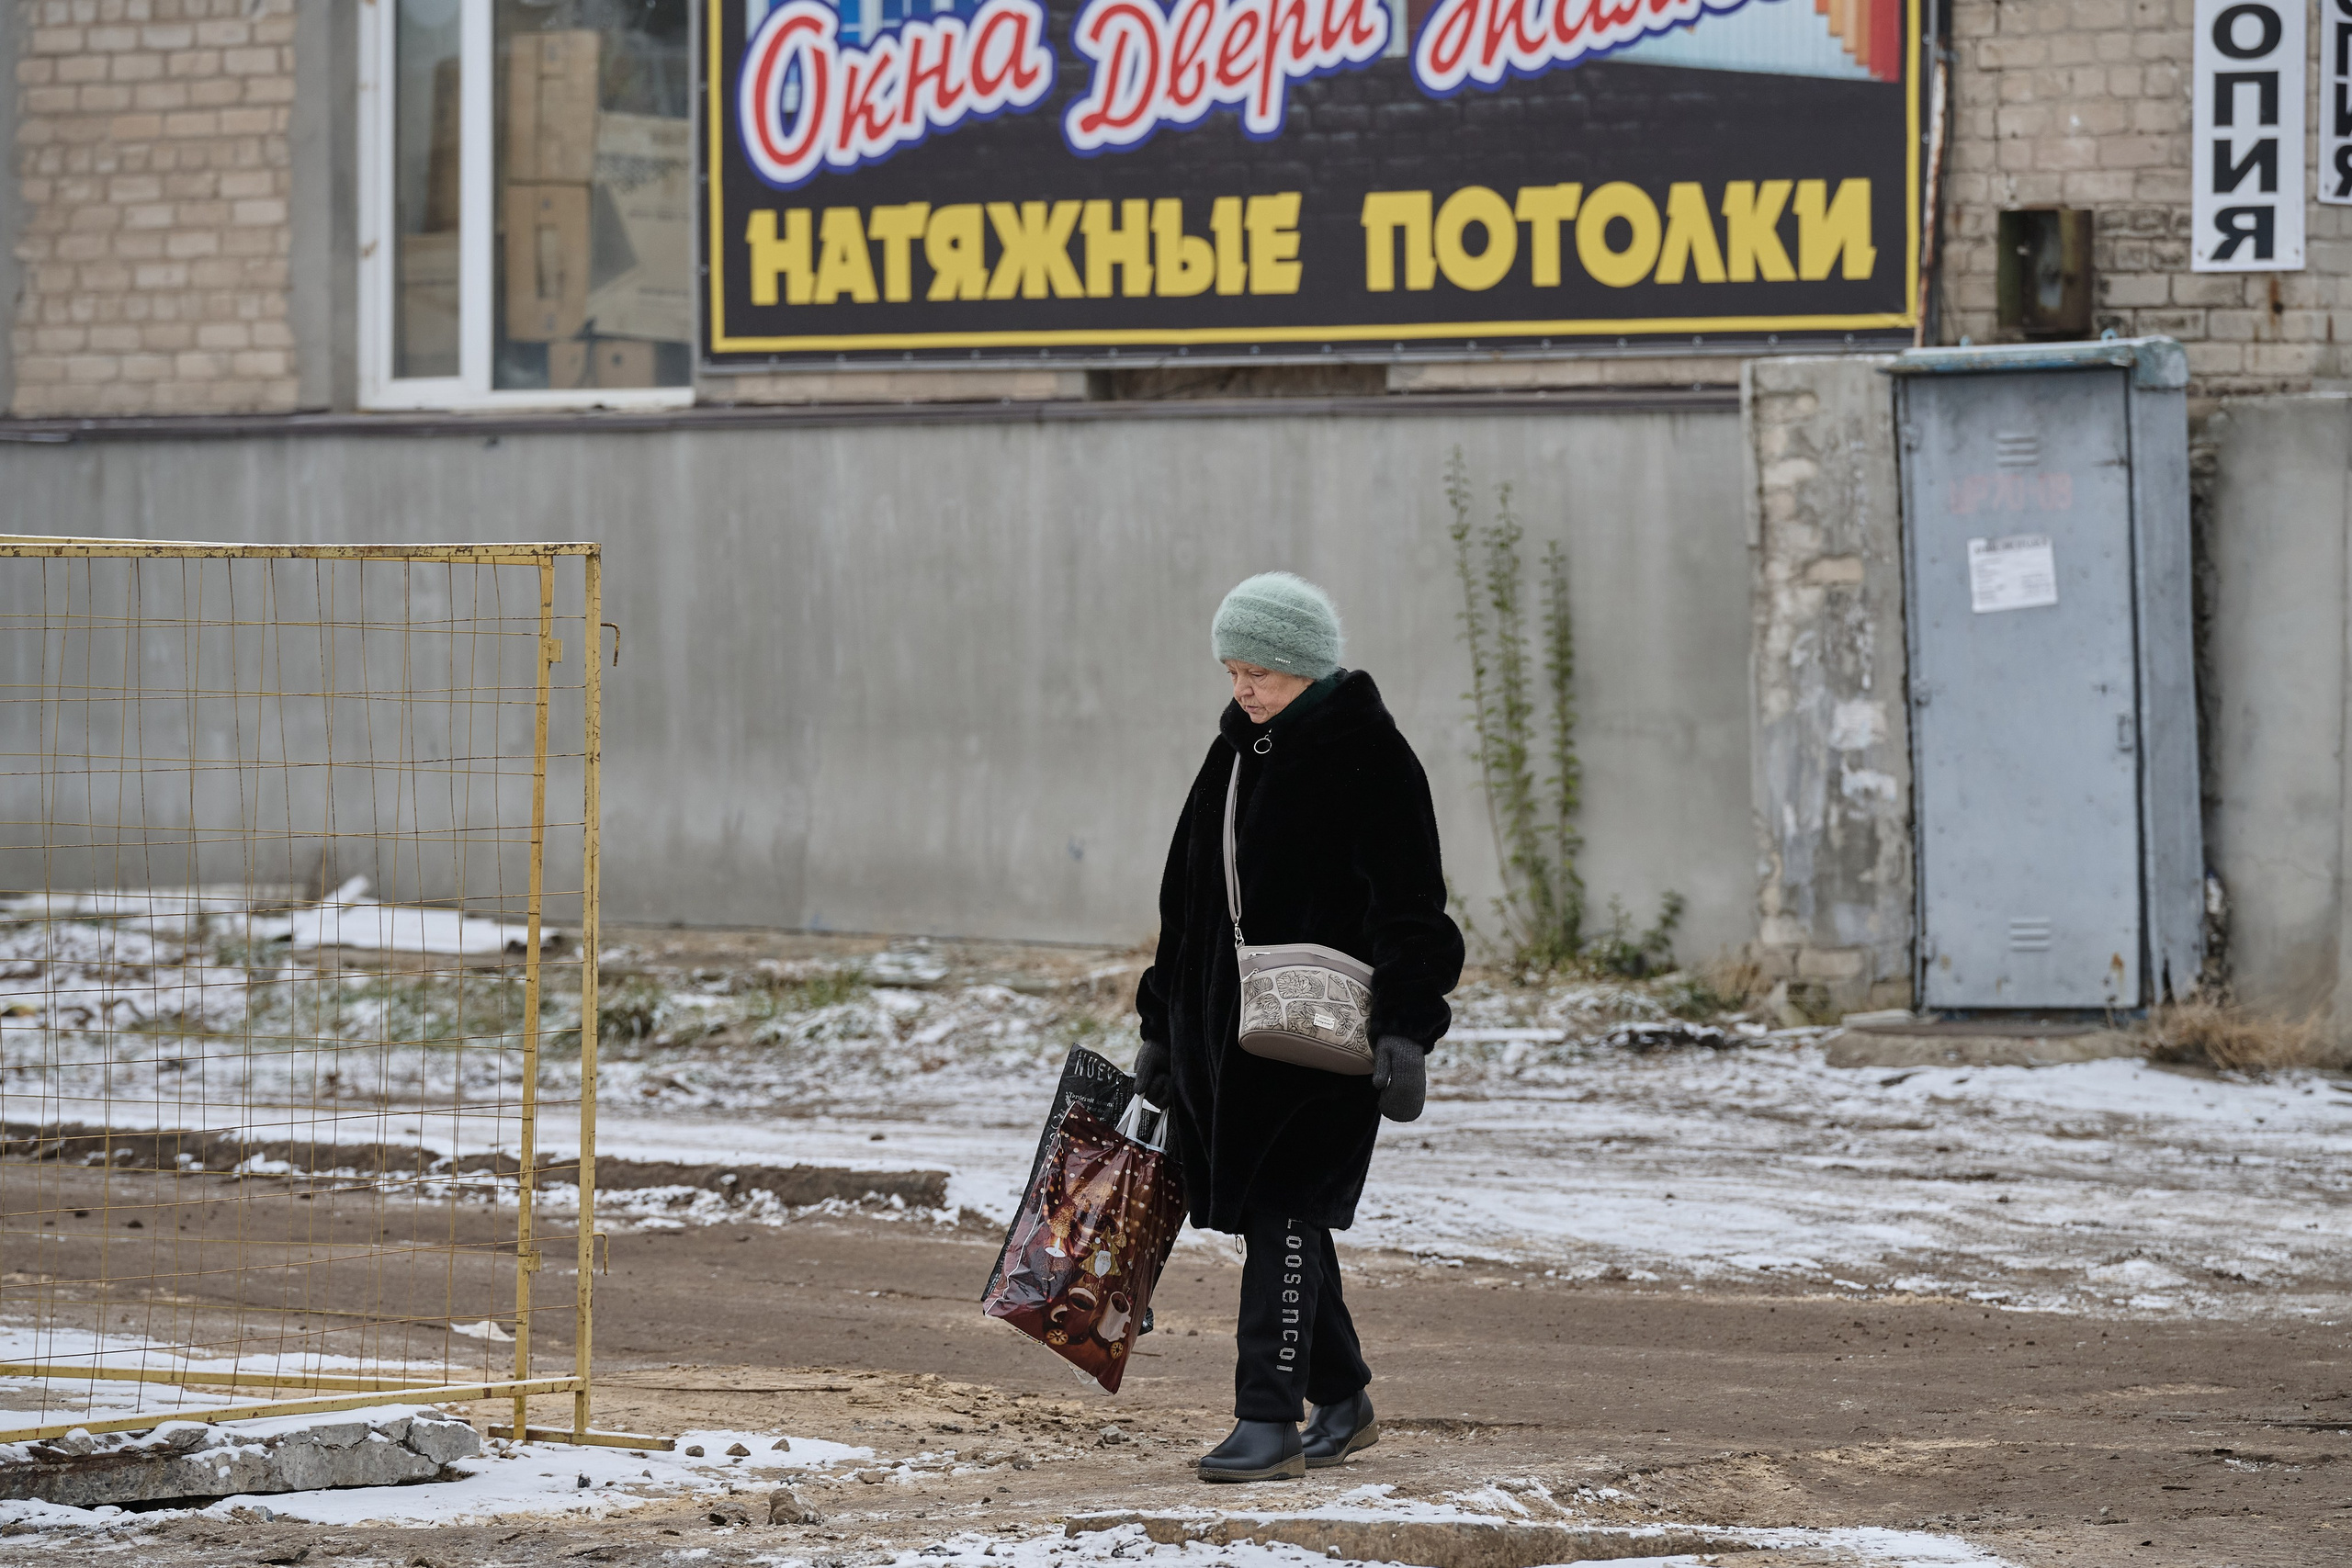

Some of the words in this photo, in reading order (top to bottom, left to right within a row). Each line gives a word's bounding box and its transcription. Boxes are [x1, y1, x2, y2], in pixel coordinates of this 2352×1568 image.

[749, 6, 1044, 172] Окна
[746, 192, 1303, 306] НАТЯЖНЫЕ
[1361, 178, 1877, 292] ПОТОЛКИ
